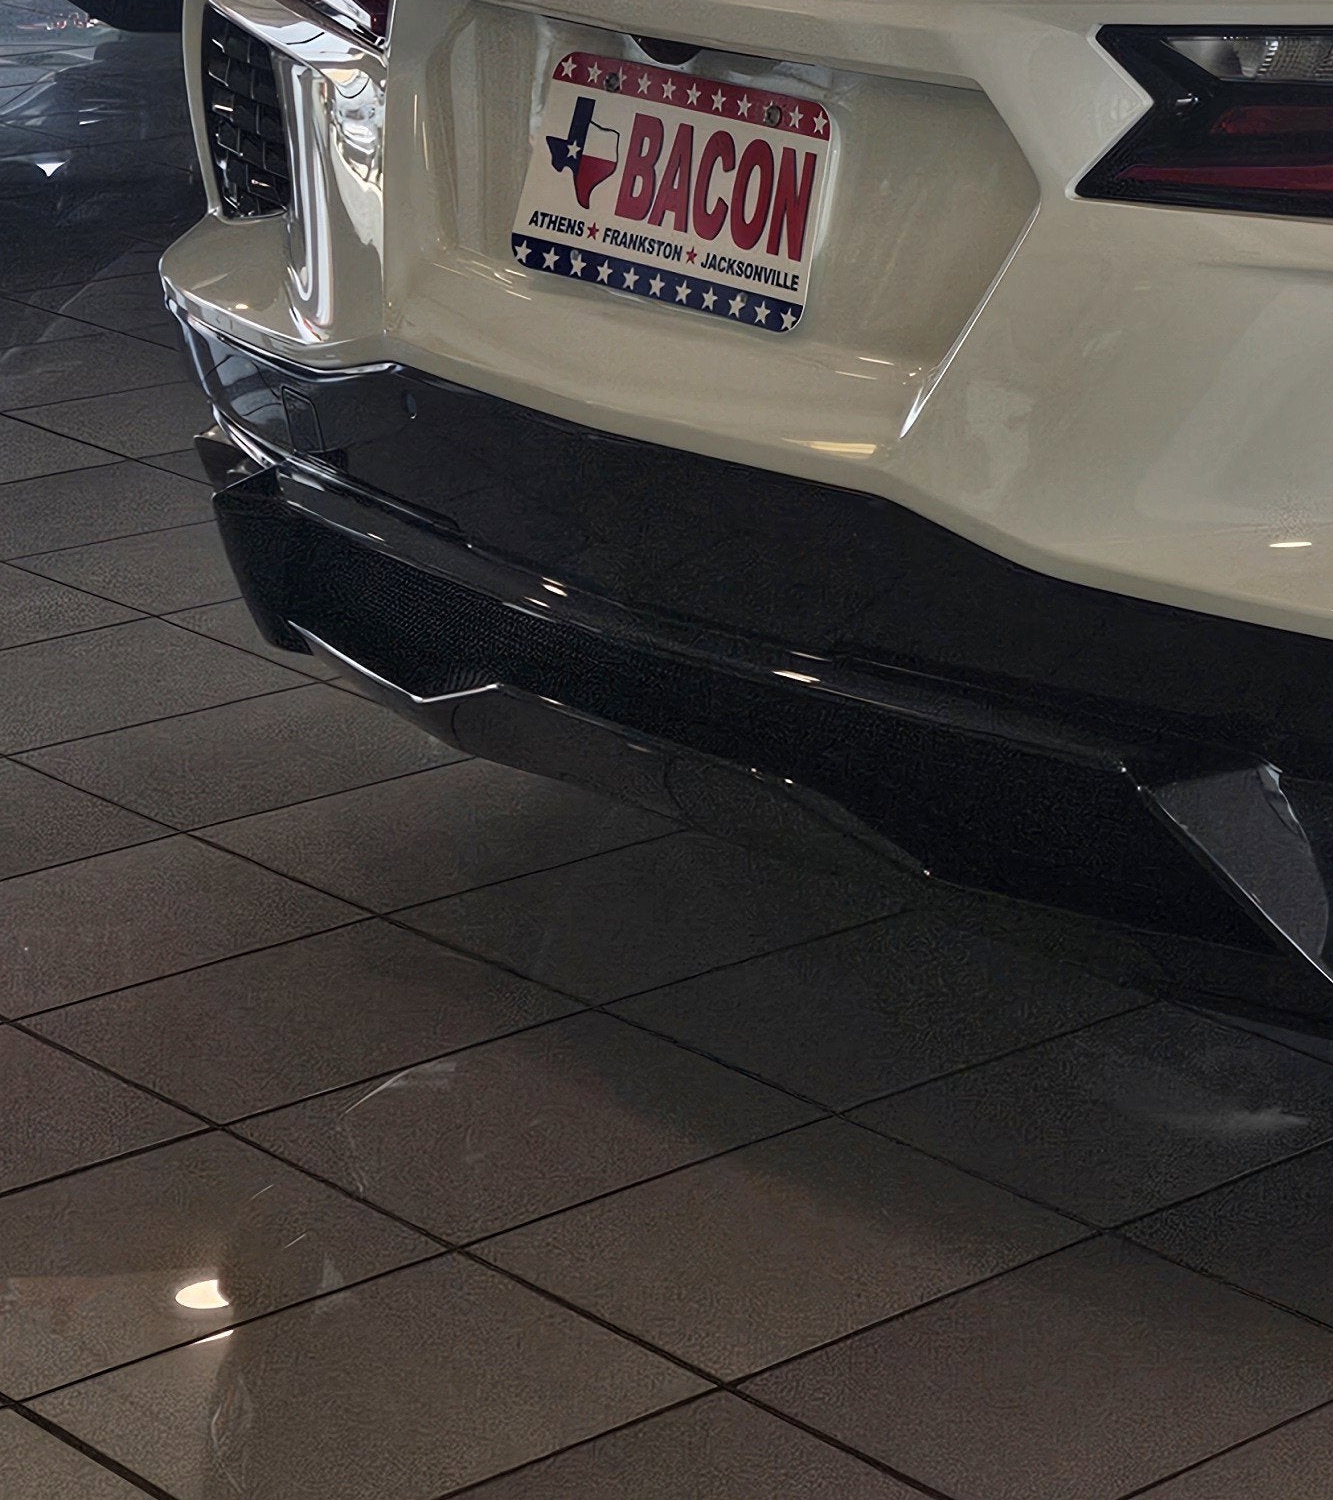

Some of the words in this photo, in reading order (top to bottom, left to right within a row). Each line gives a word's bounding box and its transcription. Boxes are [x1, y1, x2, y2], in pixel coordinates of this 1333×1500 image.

[614, 112, 818, 262] BACON
[528, 210, 585, 238] ATHENS
[602, 227, 683, 262] FRANKSTON
[701, 252, 800, 292] JACKSONVILLE
